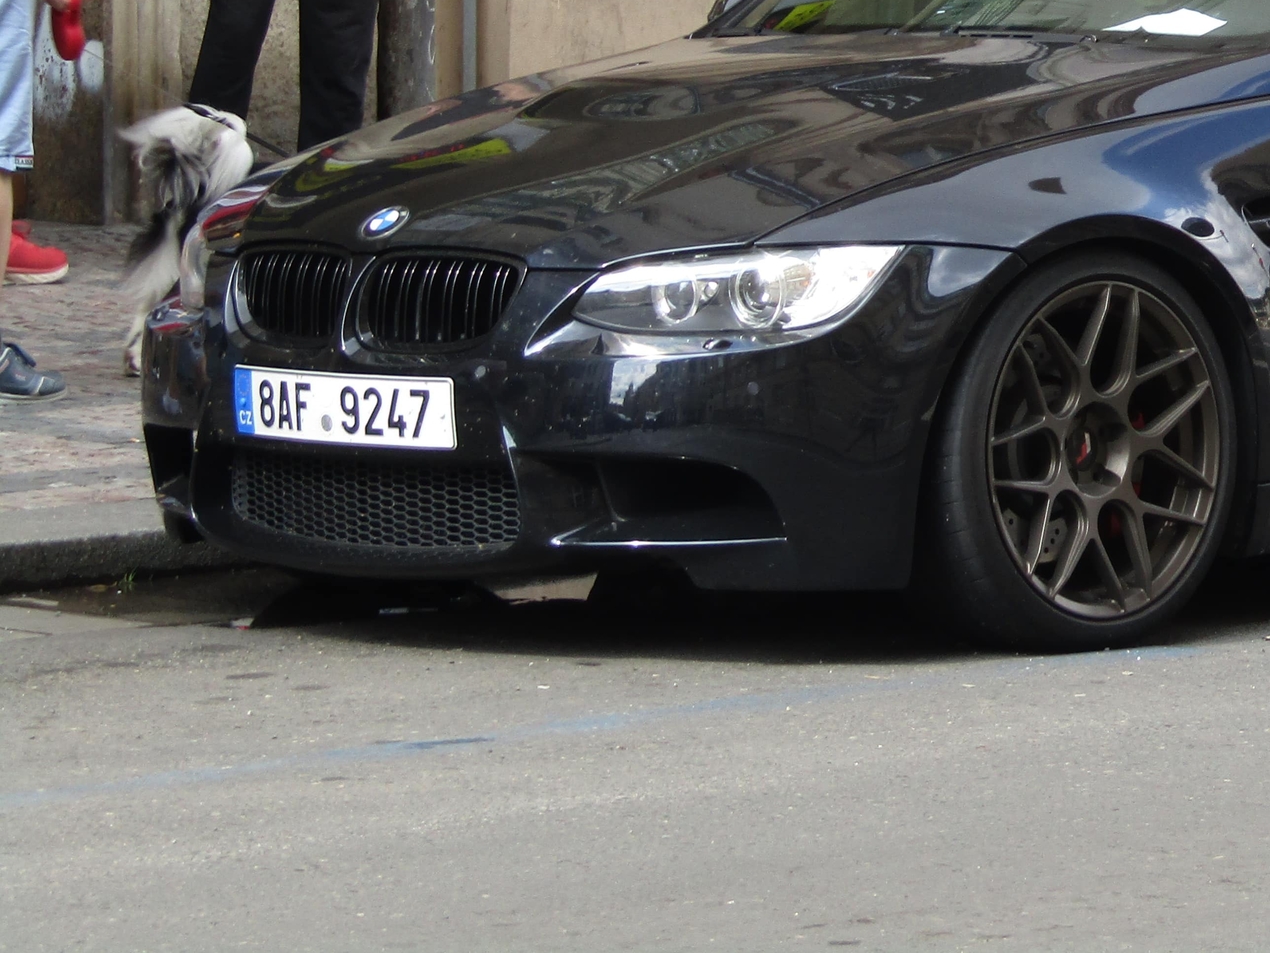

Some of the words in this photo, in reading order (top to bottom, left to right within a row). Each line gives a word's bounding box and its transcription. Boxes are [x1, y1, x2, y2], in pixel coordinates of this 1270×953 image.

[239, 410, 253, 425] CZ
[259, 379, 311, 431] 8AF
[340, 385, 430, 438] 9247
